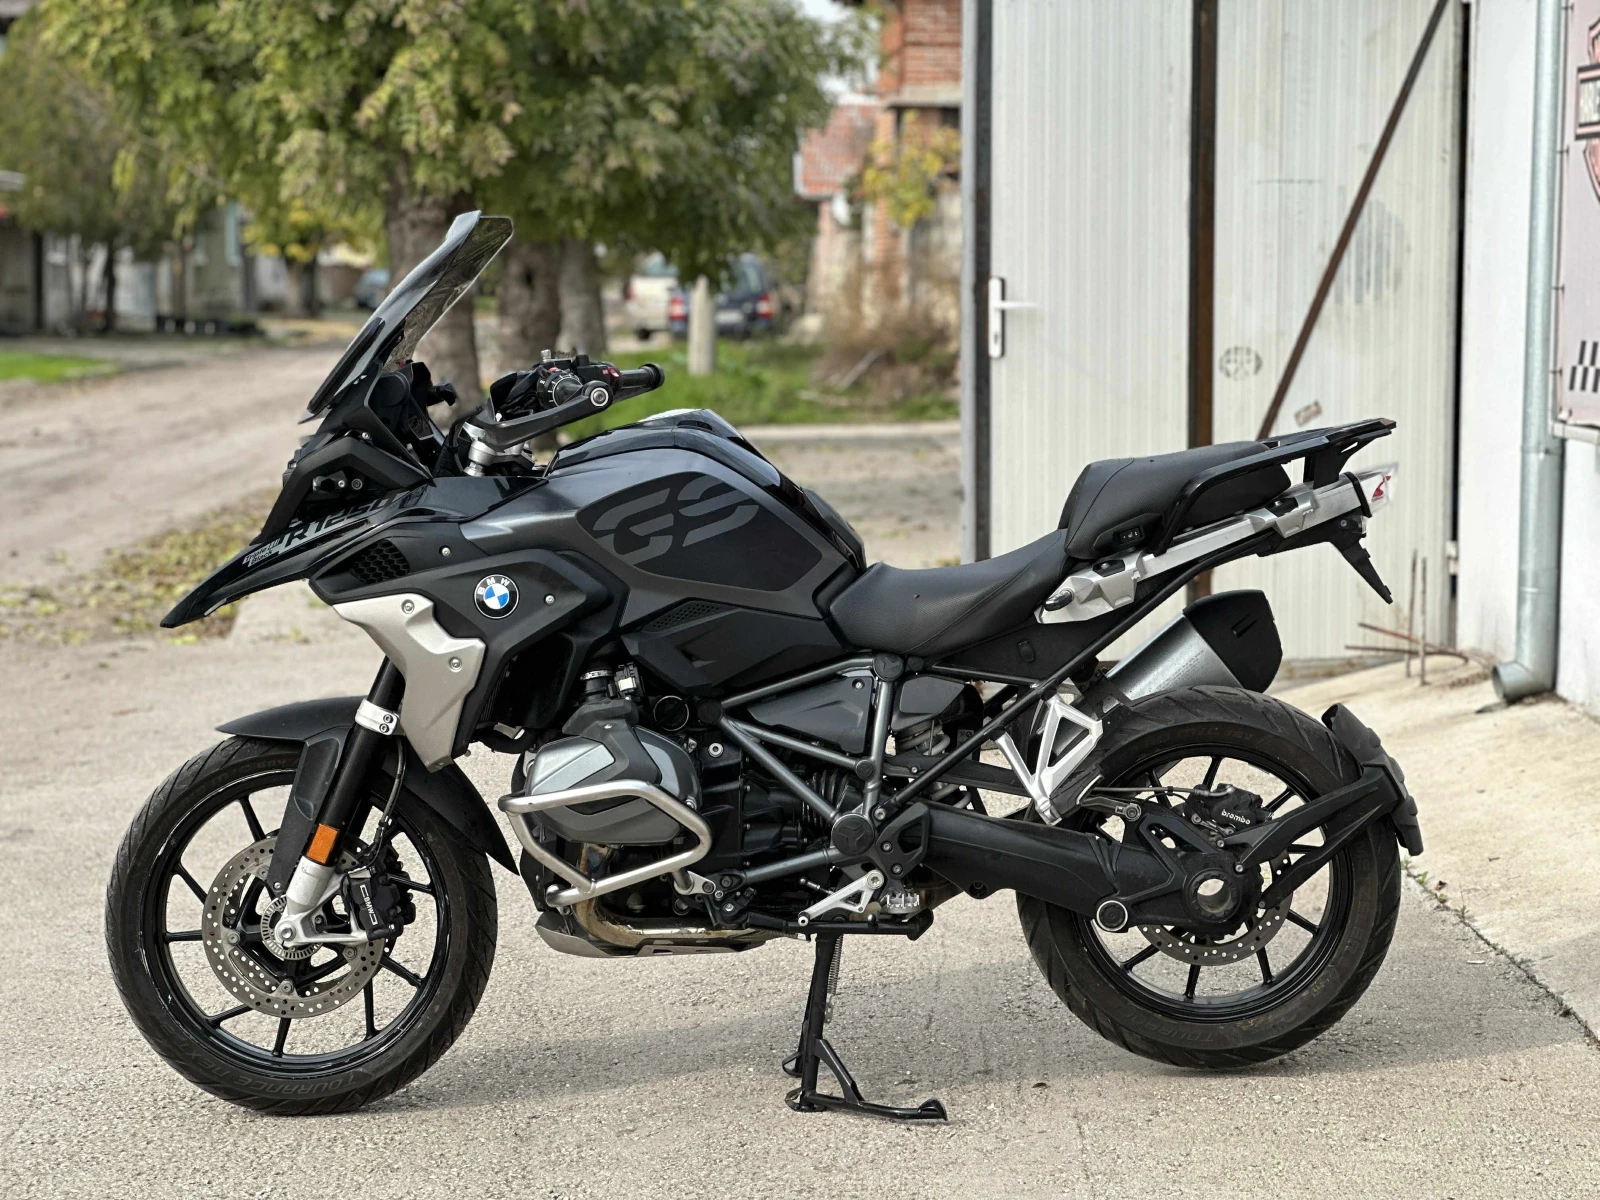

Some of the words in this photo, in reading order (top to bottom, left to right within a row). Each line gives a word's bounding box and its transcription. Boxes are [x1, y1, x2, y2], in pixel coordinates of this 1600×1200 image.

[592, 474, 760, 566] GS
[245, 545, 269, 562] Triple
[250, 550, 272, 565] Black
[477, 576, 510, 595] BMW
[1221, 809, 1251, 825] brembo
[234, 1071, 357, 1094] TOURANCE
